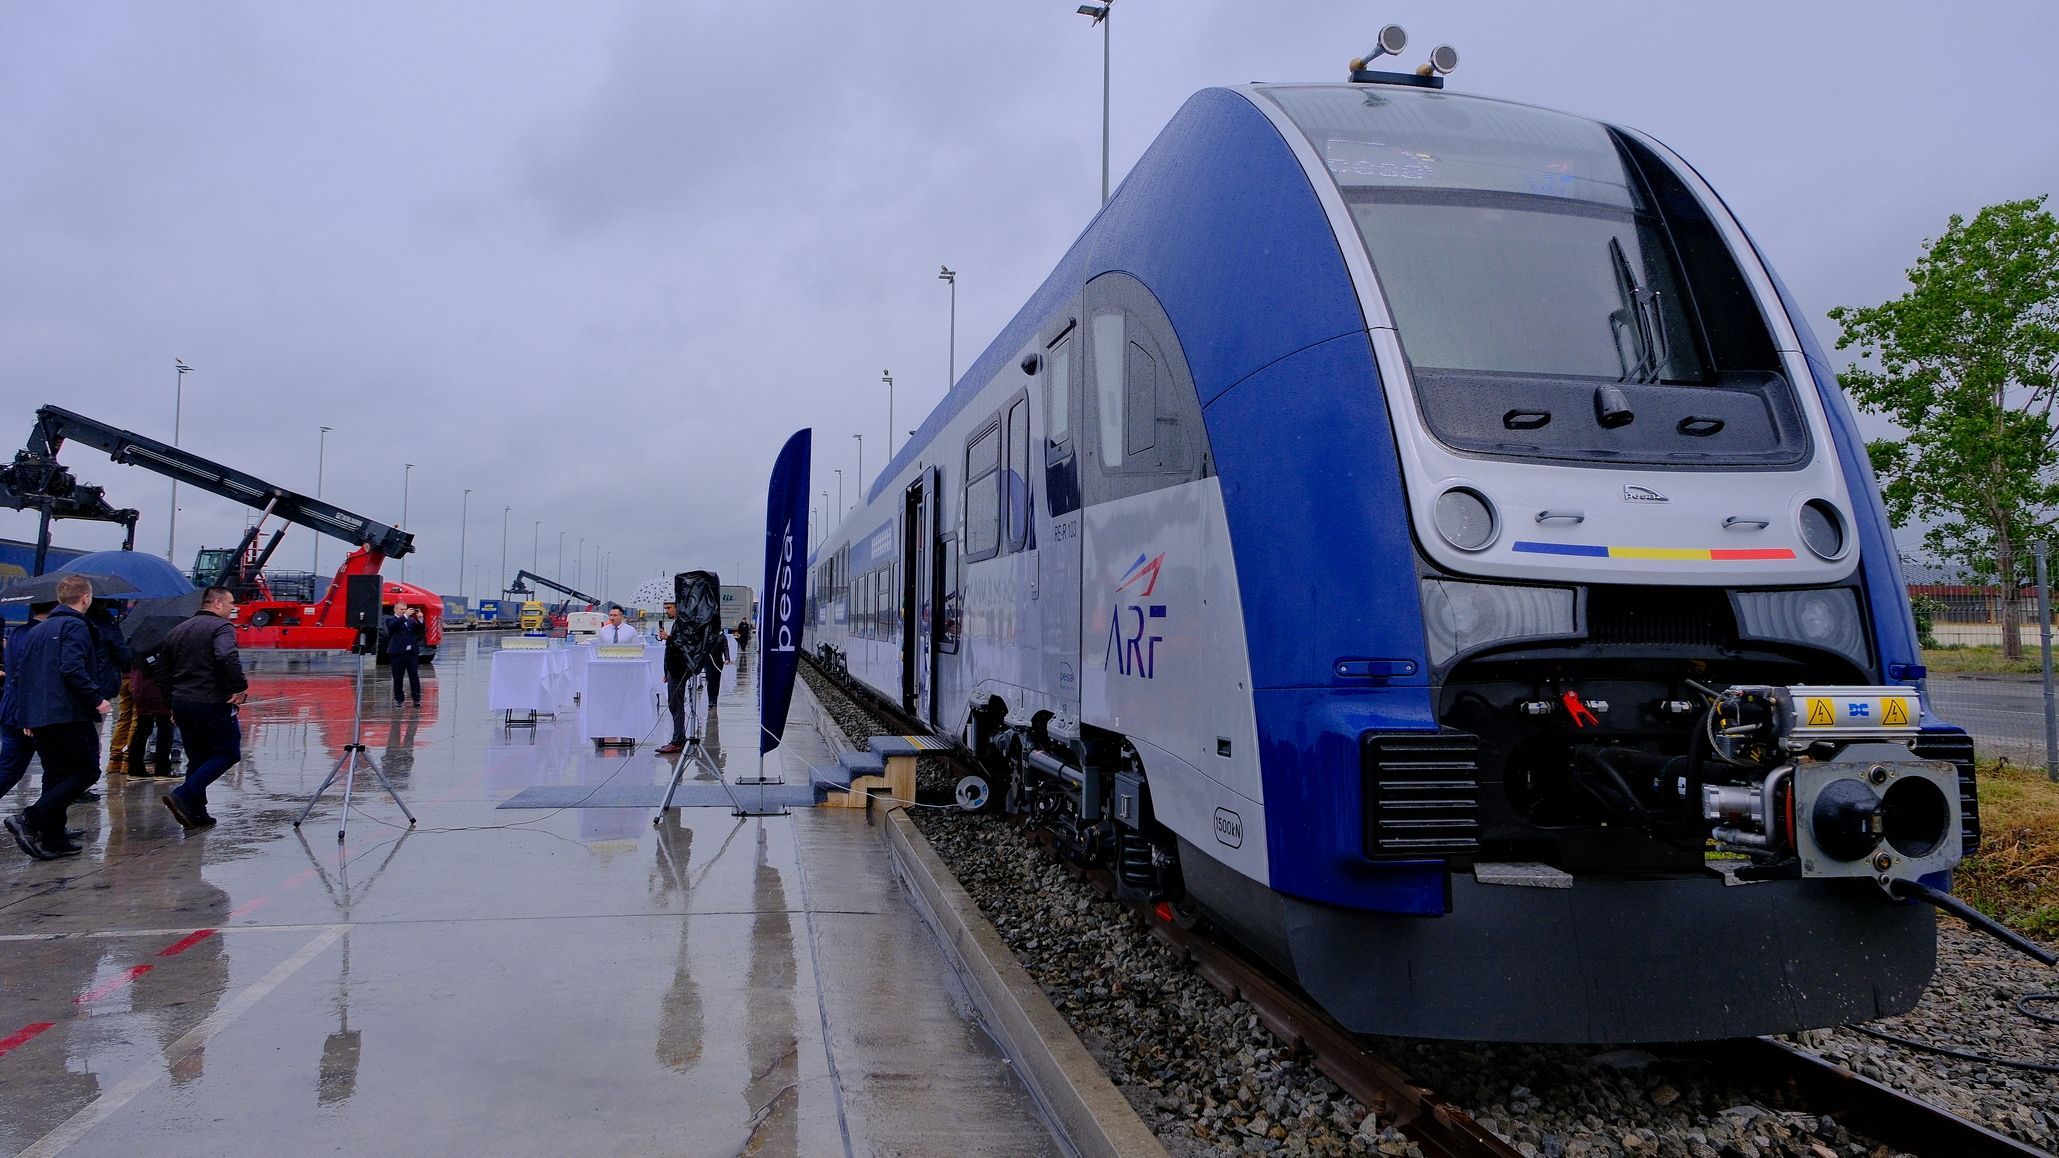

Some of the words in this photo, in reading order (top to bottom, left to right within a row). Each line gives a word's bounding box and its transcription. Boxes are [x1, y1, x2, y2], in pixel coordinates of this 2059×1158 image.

[778, 535, 795, 652] pesa
[1104, 603, 1167, 679] ARF
[1215, 816, 1241, 839] 1500kN
